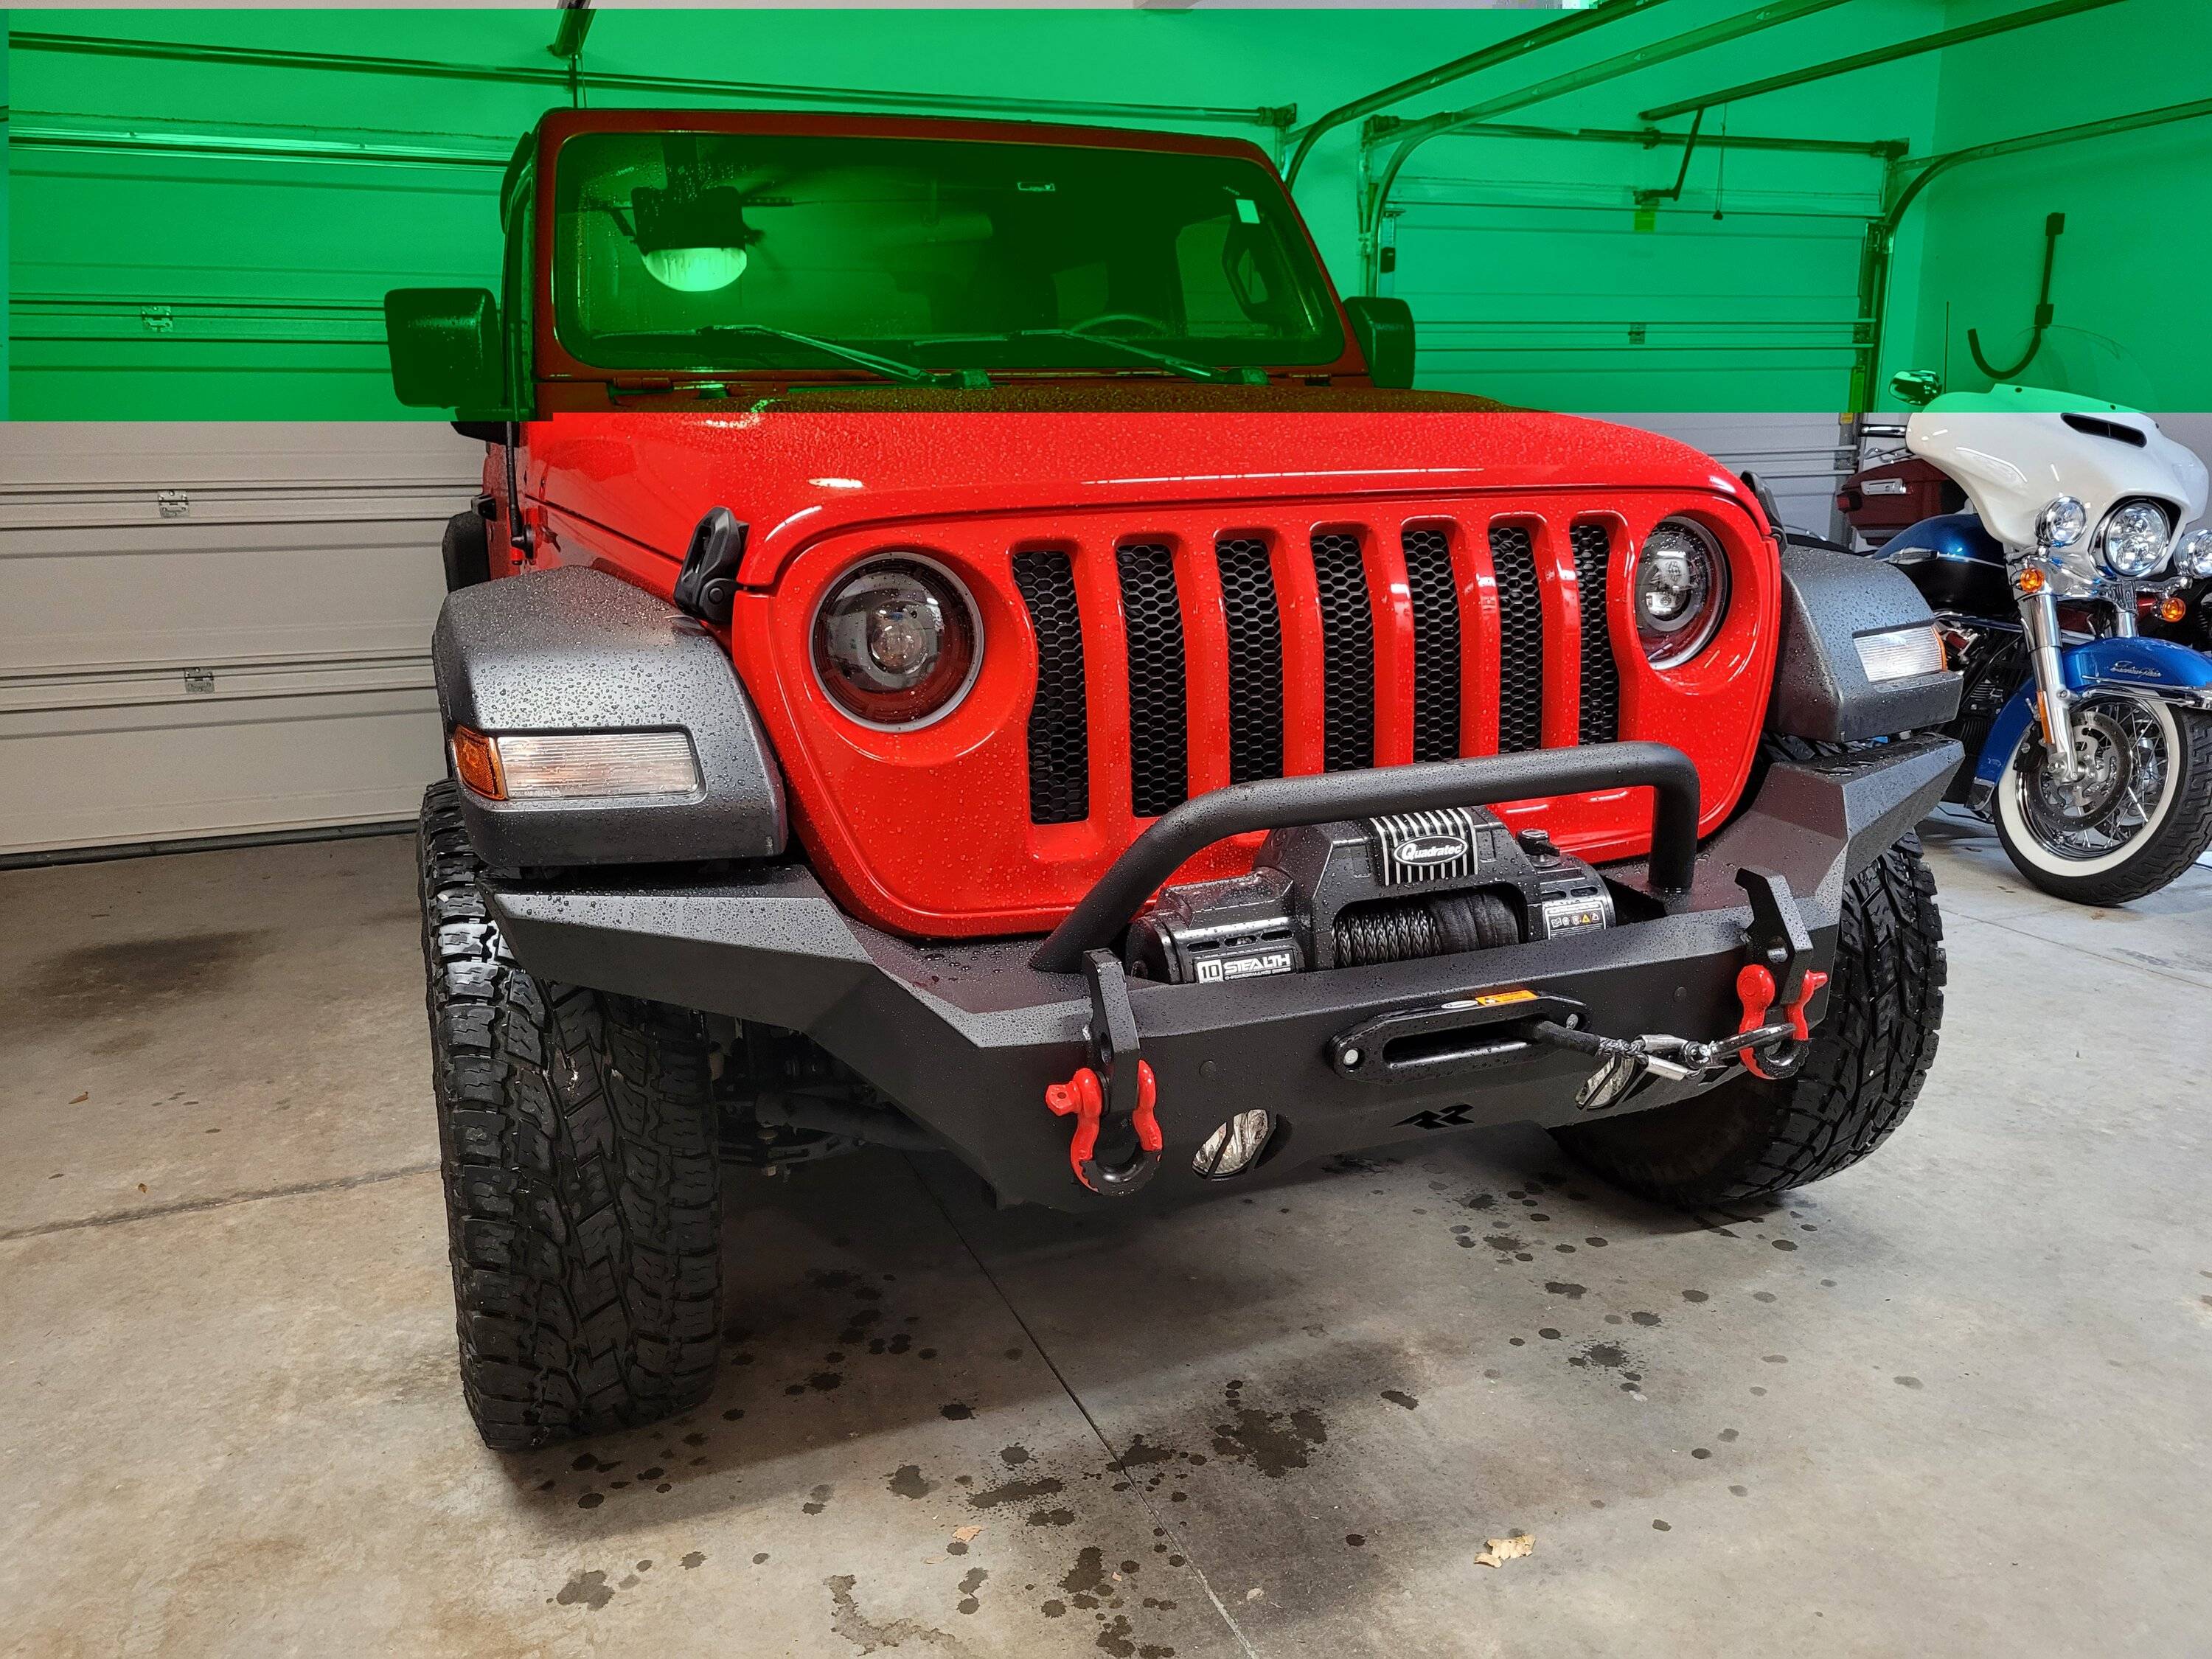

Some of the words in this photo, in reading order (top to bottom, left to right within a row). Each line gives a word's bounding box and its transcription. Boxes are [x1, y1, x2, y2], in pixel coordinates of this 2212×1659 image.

[1401, 843, 1462, 860] Quadratec
[1202, 964, 1220, 979] 10
[1224, 953, 1290, 974] STEALTH
